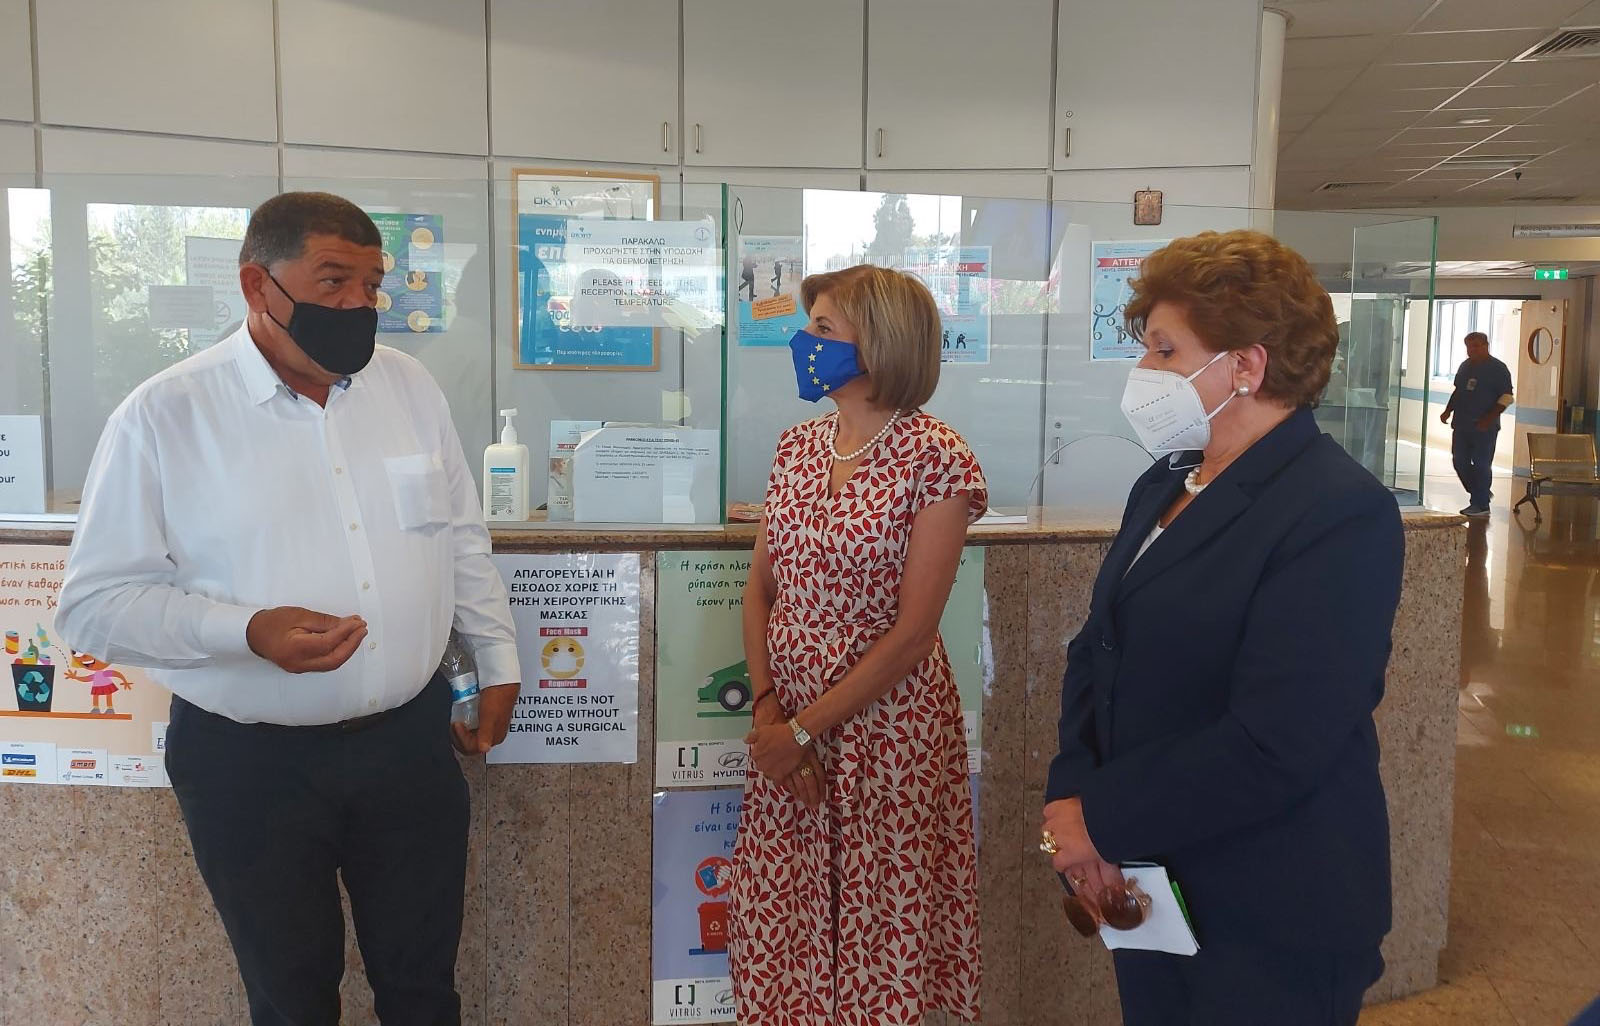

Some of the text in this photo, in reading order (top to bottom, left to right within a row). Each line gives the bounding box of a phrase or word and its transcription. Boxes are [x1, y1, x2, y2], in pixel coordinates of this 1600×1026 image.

[622, 237, 666, 246] ΠΑΡΑΚΑΛΩ
[583, 247, 703, 255] ΠΡΟΧΩΡΗΣΤΕ ΣΤΗΝ ΥΠΟΔΟΧΗ
[602, 257, 684, 265] ΓΙΑ ΘΕΡΜΟΜΕΤΡΗΣΗ
[592, 278, 623, 286] PLEASE
[581, 288, 627, 296] RECEPTION
[614, 298, 674, 306] TEMPERATURE
[0, 475, 15, 484] our
[0, 560, 65, 571] ντική εκπαίδ
[680, 560, 752, 575] Η χρήση ηλεκ
[513, 569, 615, 579] ΑΠΑΓΟΡΕΥΕΤΑΙ Η
[1, 578, 23, 588] έναν
[511, 583, 617, 592] ΕΙΣΟΔΟΣ ΧΩΡΙΣ ΤΗ
[687, 578, 730, 592] ρύπανση
[0, 598, 20, 606] ωση
[24, 598, 42, 607] στη
[509, 597, 626, 606] ΡΗΣΗ ΧΕΙΡΟΥΡΓΙΚΗΣ
[696, 597, 724, 606] έχουν
[540, 610, 588, 620] ΜΑΣΚΑΣ
[546, 628, 582, 636] Face Mask
[548, 680, 578, 688] Required
[576, 695, 588, 705] IS
[591, 695, 615, 705] NOT
[566, 708, 620, 718] WITHOUT
[509, 722, 626, 733] EARING A SURGICAL
[546, 736, 579, 746] MASK
[672, 769, 704, 780] VITRUS
[711, 803, 720, 815] Η
[695, 821, 721, 833] είναι
[669, 1007, 702, 1018] VITRUS
